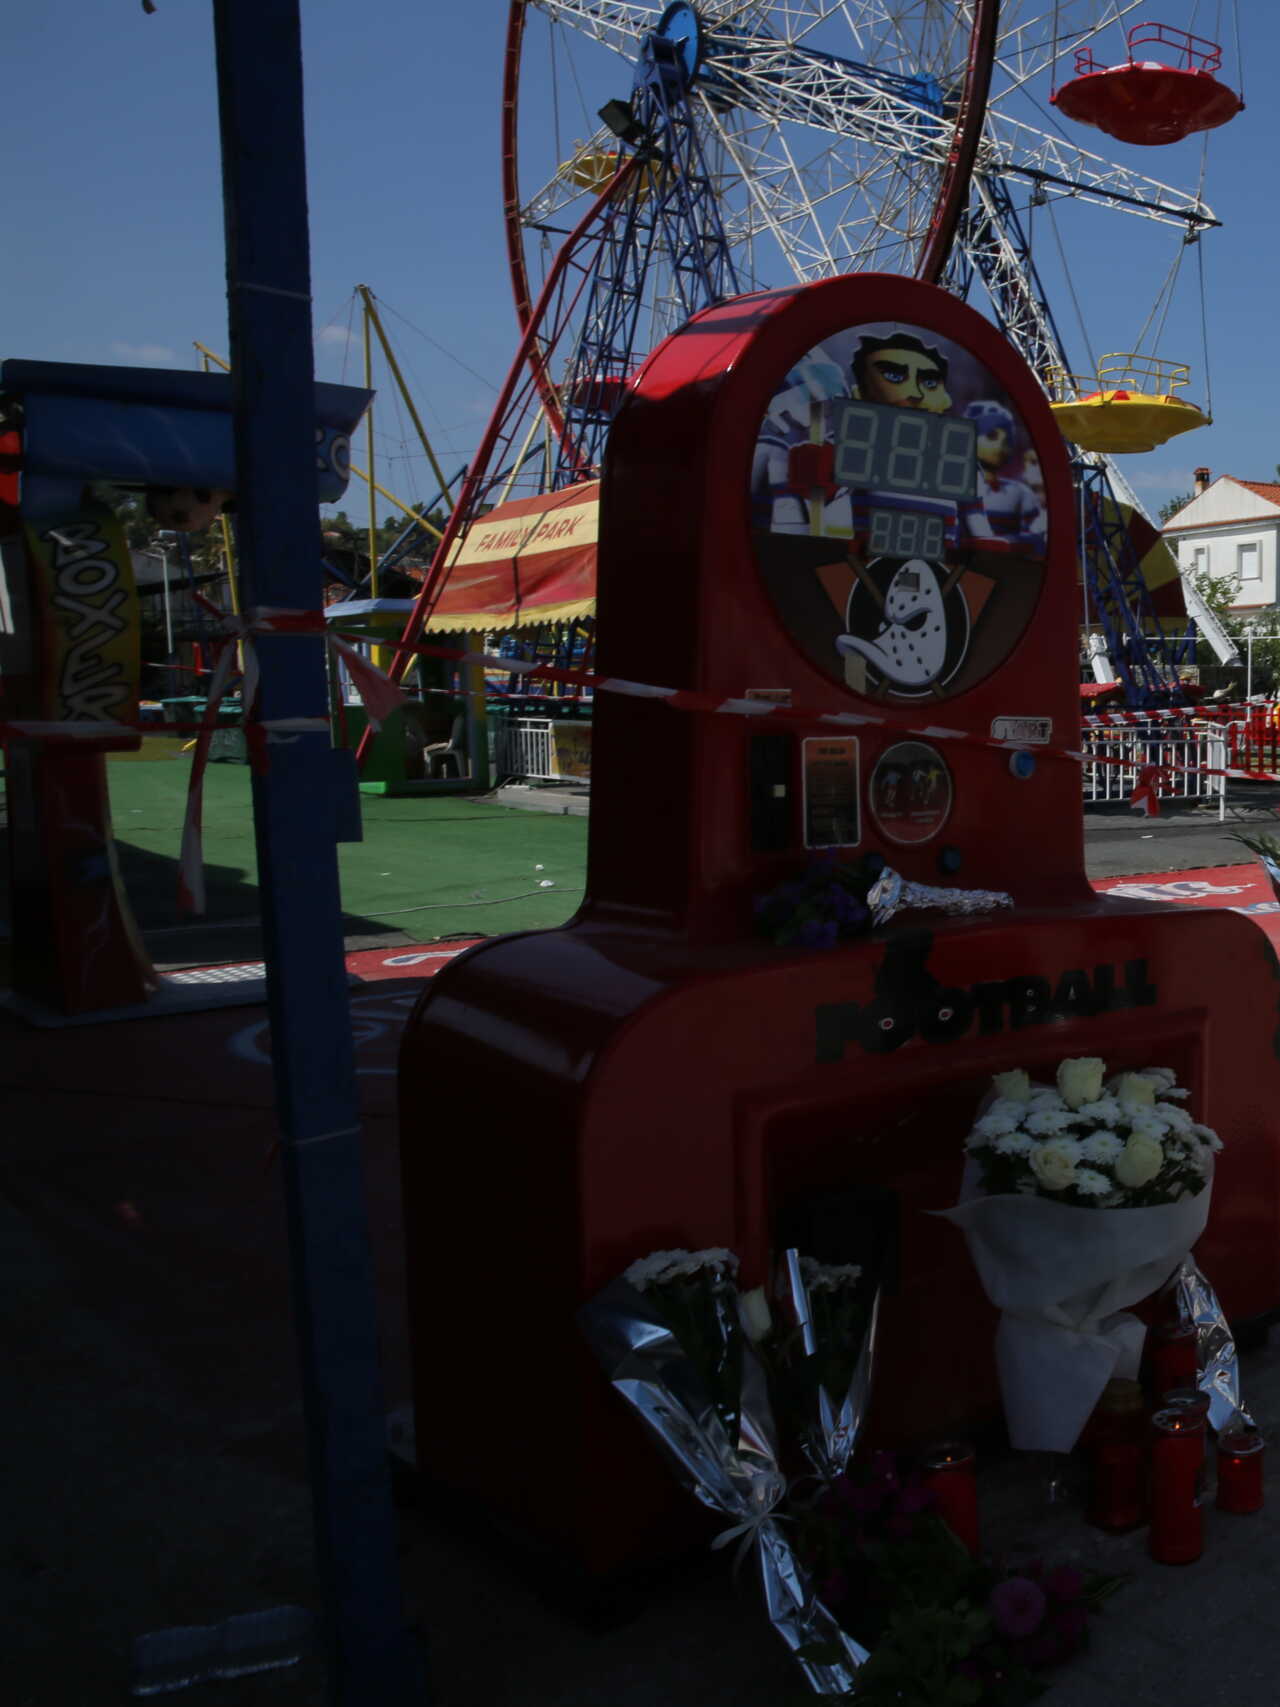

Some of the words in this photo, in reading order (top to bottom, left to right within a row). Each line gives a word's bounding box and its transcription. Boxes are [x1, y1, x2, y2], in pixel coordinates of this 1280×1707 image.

[475, 528, 535, 552] FAMILY
[531, 515, 584, 544] PARK
[815, 957, 1158, 1064] FOOTBALL
